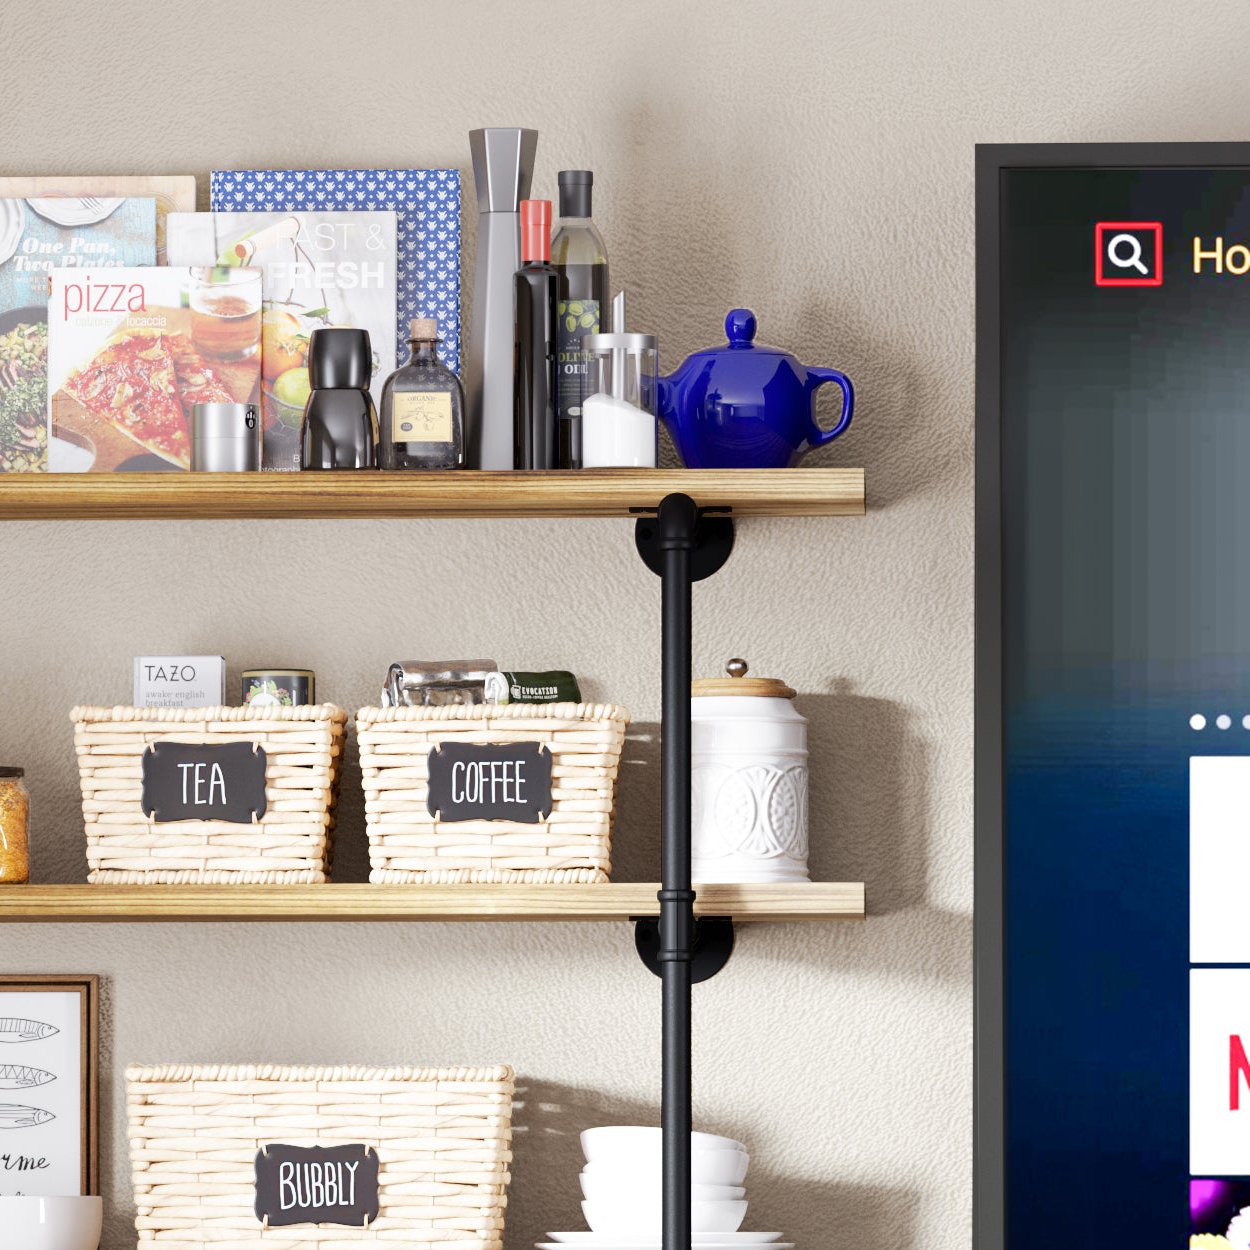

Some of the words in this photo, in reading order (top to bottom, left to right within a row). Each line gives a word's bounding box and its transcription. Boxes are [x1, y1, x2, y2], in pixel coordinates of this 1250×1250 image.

[276, 222, 356, 251] FAST
[365, 222, 387, 251] &
[22, 237, 64, 254] One
[68, 237, 116, 257] Pan,
[13, 255, 54, 272] Two
[60, 254, 125, 267] Plates
[267, 261, 385, 289] FRESH
[64, 275, 148, 321] pizza
[125, 315, 167, 327] focaccia
[564, 364, 589, 375] OIL
[144, 665, 196, 682] TAZO
[145, 690, 171, 698] awake
[175, 690, 205, 700] english
[521, 686, 558, 696] EVOCATION
[145, 699, 184, 707] breakfast
[177, 762, 227, 806] TEA
[451, 760, 528, 804] COFFEE
[279, 1160, 360, 1210] BUBBLY
